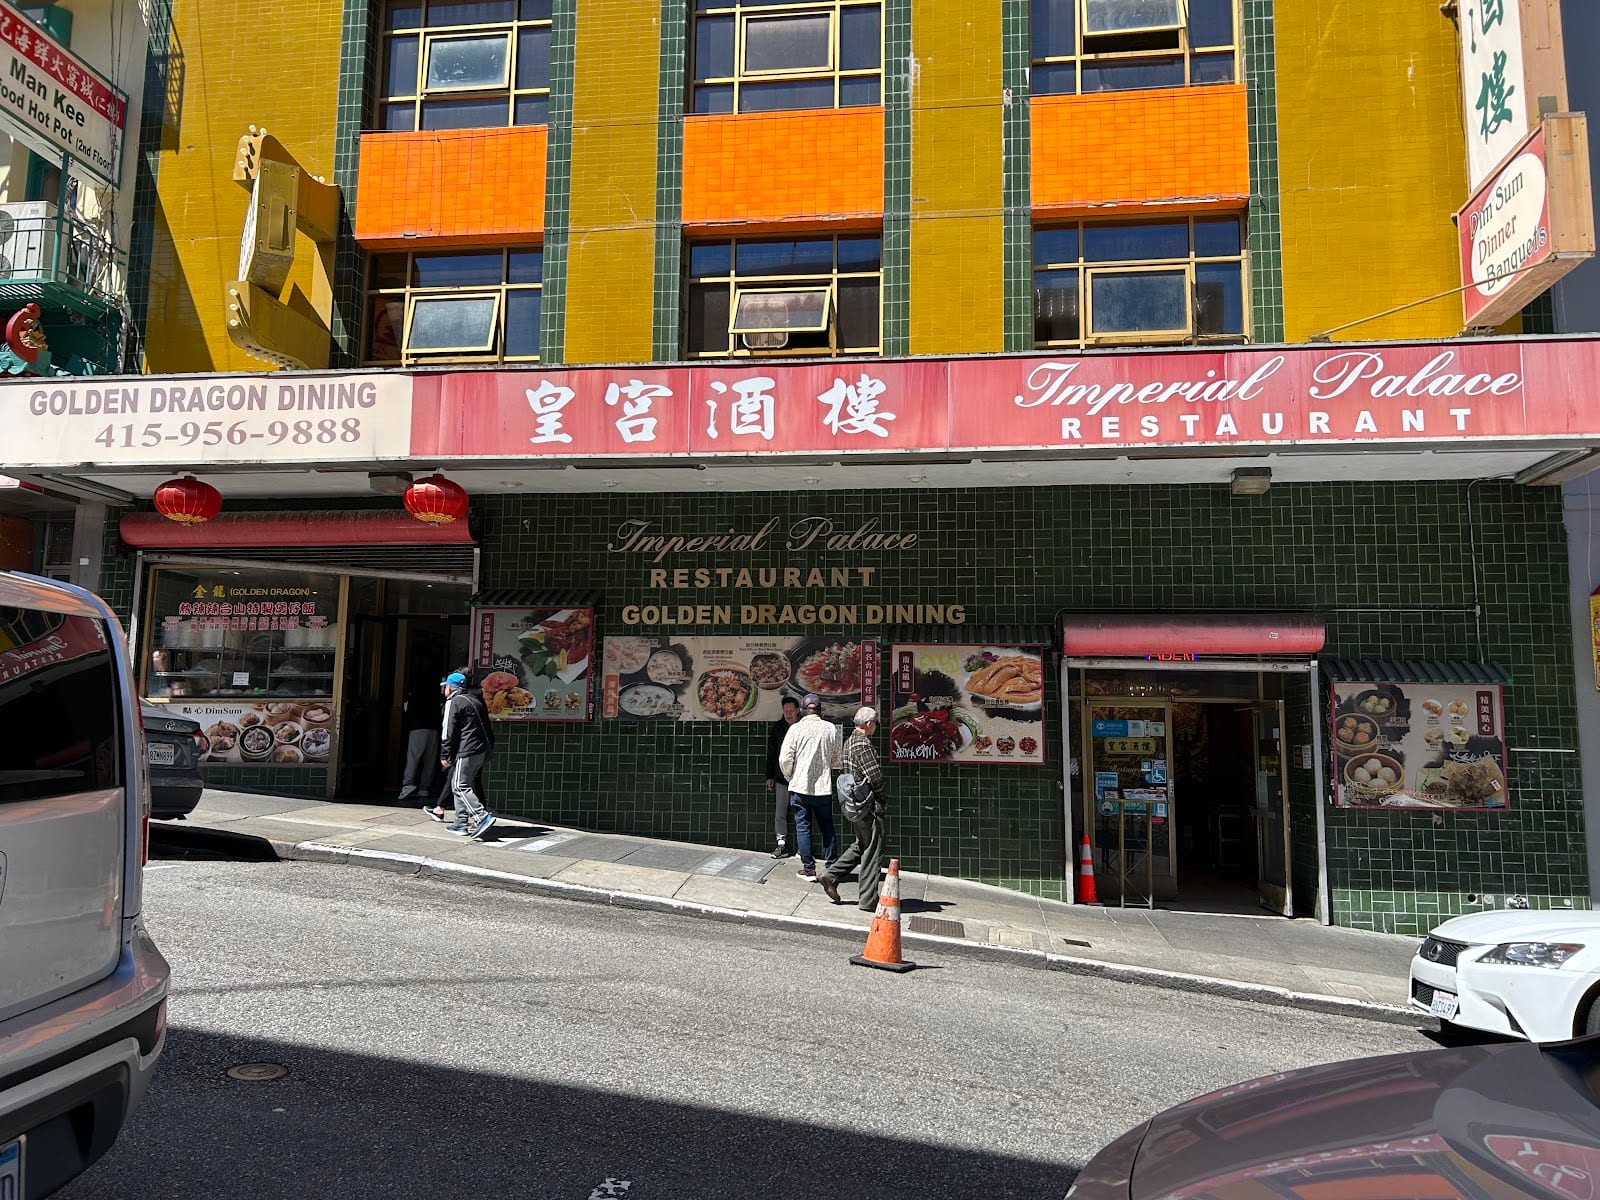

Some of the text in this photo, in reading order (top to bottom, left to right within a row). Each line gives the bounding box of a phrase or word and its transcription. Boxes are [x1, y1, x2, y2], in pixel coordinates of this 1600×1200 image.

[9, 56, 86, 128] Man Kee
[28, 99, 50, 128] Hot
[53, 118, 73, 145] Pot
[75, 136, 92, 159] (2nd
[1469, 171, 1524, 240] Dim Sum
[1478, 214, 1517, 267] Dinner
[1485, 224, 1548, 292] Banquets
[29, 381, 377, 416] GOLDEN DRAGON DINING
[1013, 351, 1525, 417] Imperial Palace
[525, 372, 896, 444] 皇宮酒樓
[1061, 407, 1472, 440] RESTAURANT
[94, 417, 362, 448] 415-956-9888
[607, 515, 918, 563] Imperial Palace
[192, 584, 226, 598] 金龍
[230, 587, 311, 597] (GOLDEN DRAGON)
[650, 566, 877, 589] RESTAURANT
[621, 604, 966, 625] GOLDEN DRAGON DINING
[182, 706, 203, 715] 點心
